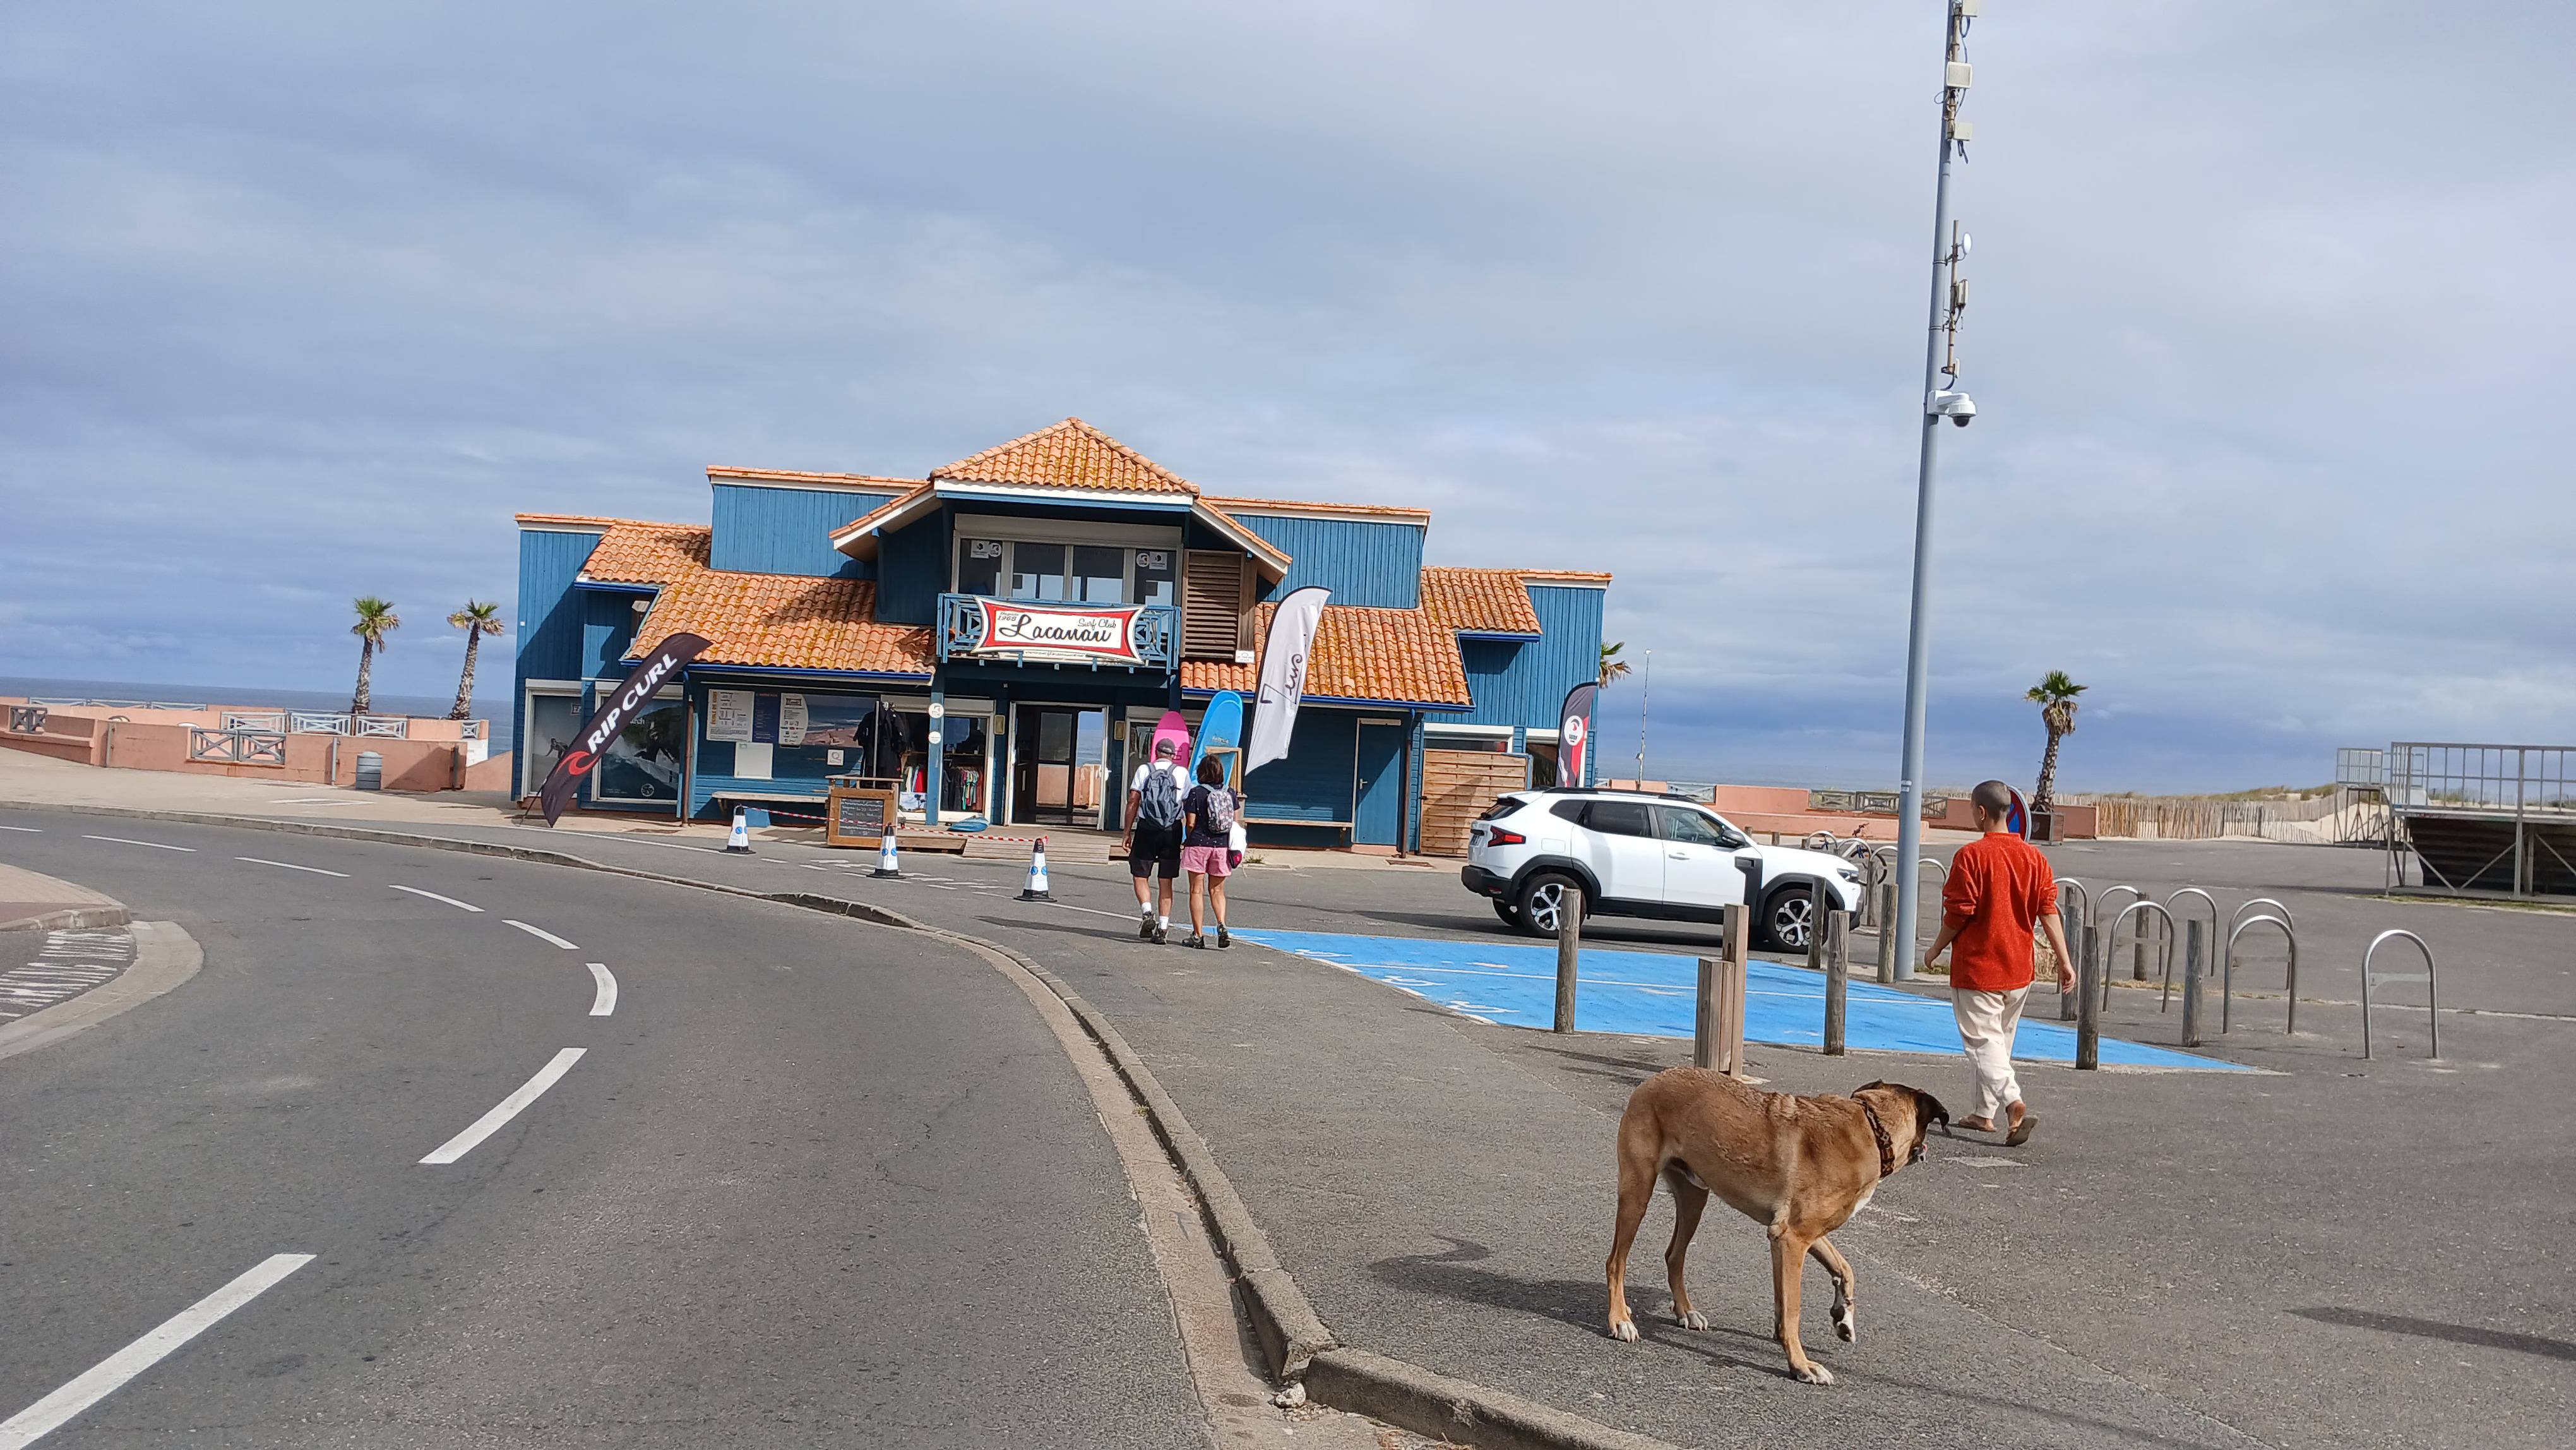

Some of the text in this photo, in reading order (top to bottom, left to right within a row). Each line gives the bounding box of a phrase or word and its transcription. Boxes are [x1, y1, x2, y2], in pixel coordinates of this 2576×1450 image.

[999, 614, 1111, 642] Lacanau
[1077, 618, 1116, 631] Surf Club
[587, 707, 620, 753] RIP
[623, 654, 677, 711] CURL
